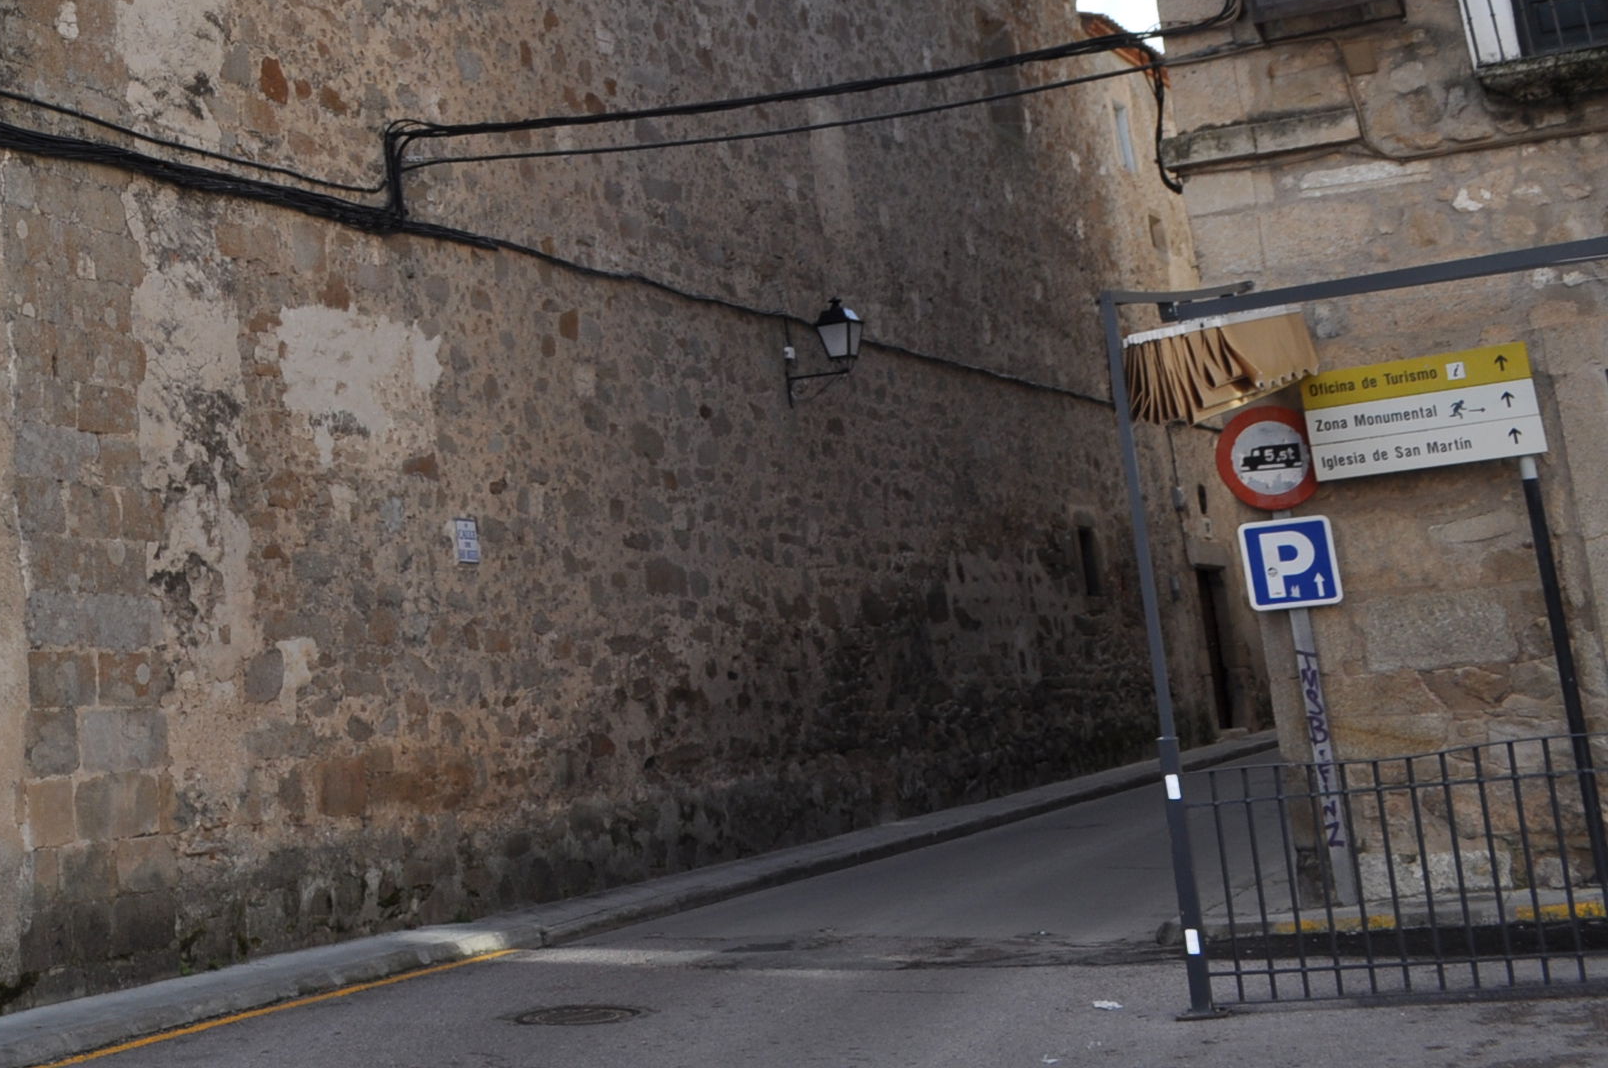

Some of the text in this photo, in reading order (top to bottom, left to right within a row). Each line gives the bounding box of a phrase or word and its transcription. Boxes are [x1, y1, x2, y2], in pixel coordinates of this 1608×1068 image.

[1309, 380, 1355, 397] Oficina
[1361, 375, 1377, 389] de
[1384, 369, 1438, 385] Turismo
[1315, 405, 1438, 433] Zona Monumental
[1321, 437, 1473, 471] Iglesia de San Martín
[1259, 531, 1315, 599] P
